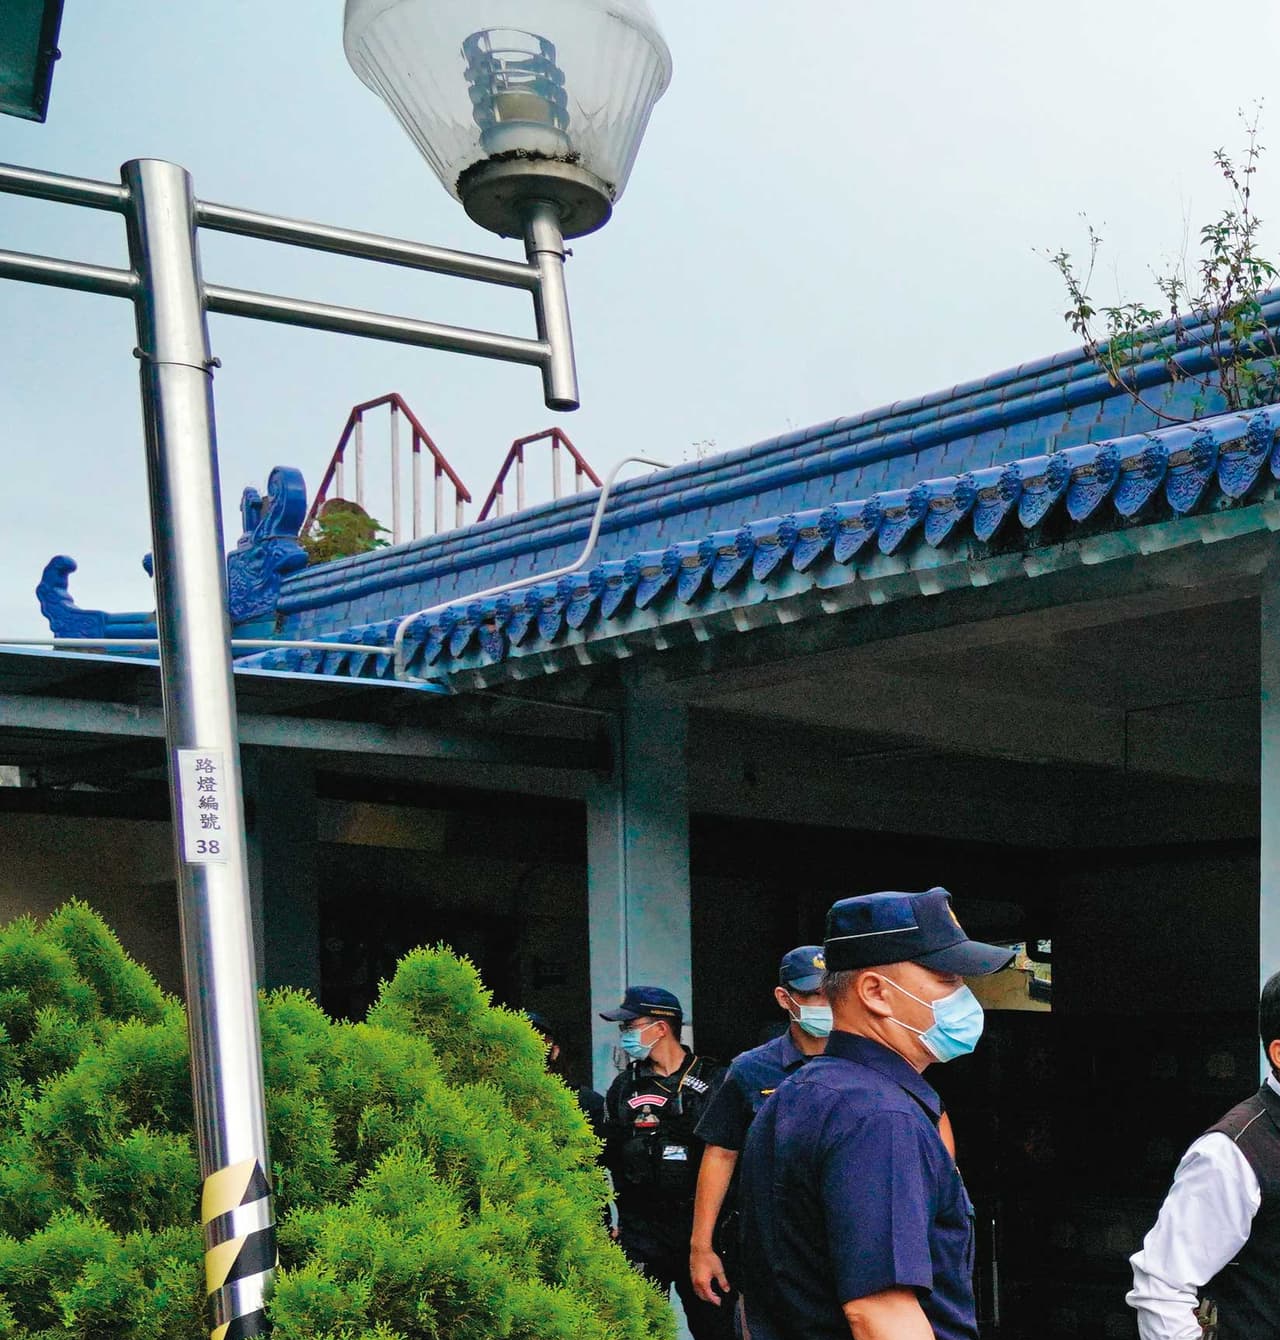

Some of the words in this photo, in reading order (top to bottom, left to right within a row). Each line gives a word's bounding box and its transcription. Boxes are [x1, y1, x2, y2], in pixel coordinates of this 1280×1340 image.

[195, 758, 221, 830] 路燈編號
[196, 839, 220, 854] 38
